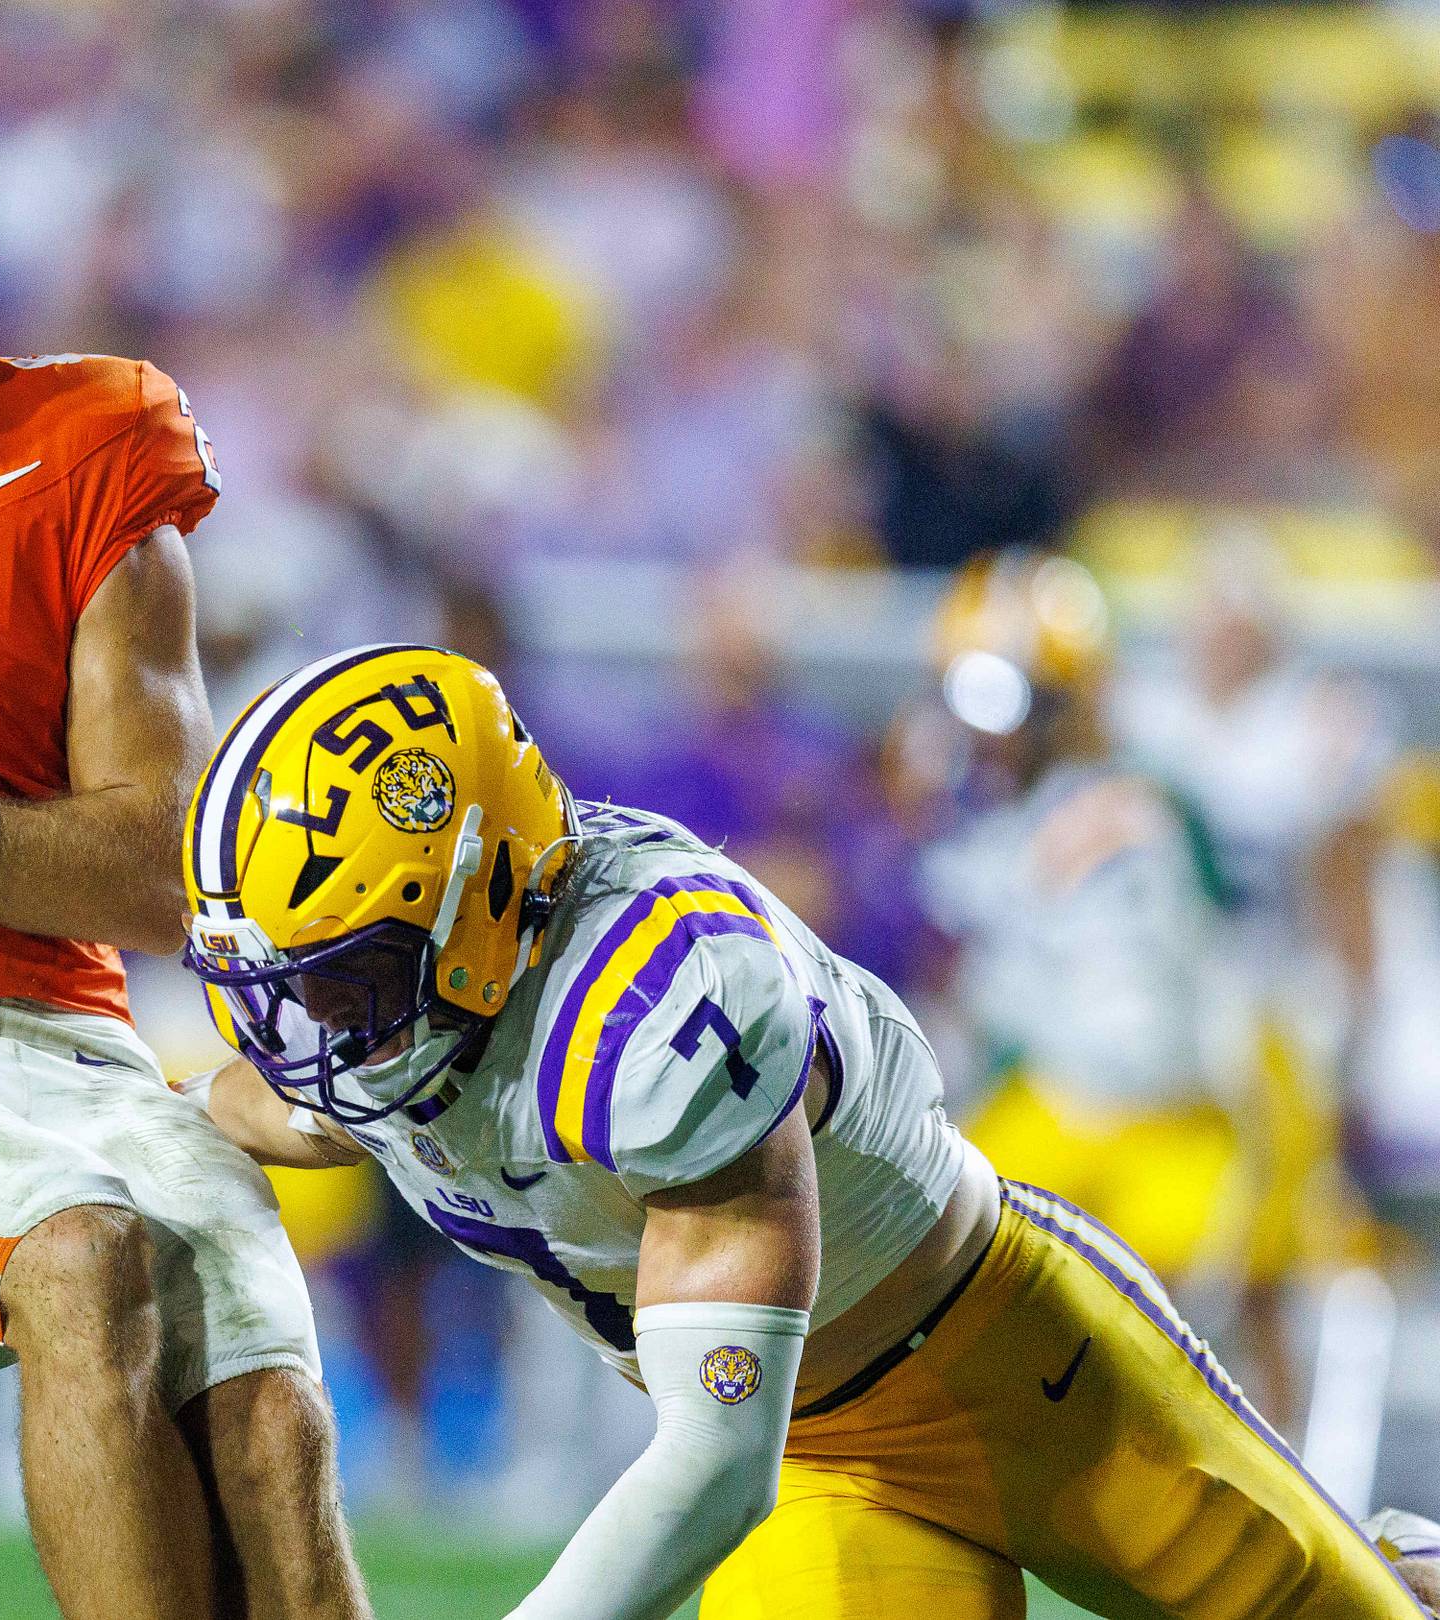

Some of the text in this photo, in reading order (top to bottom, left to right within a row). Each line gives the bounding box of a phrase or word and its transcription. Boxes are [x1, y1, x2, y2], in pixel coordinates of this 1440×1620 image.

[275, 674, 452, 838] LSU
[200, 929, 241, 955] LSU
[669, 995, 761, 1101] 7
[435, 1187, 494, 1218] LSU
